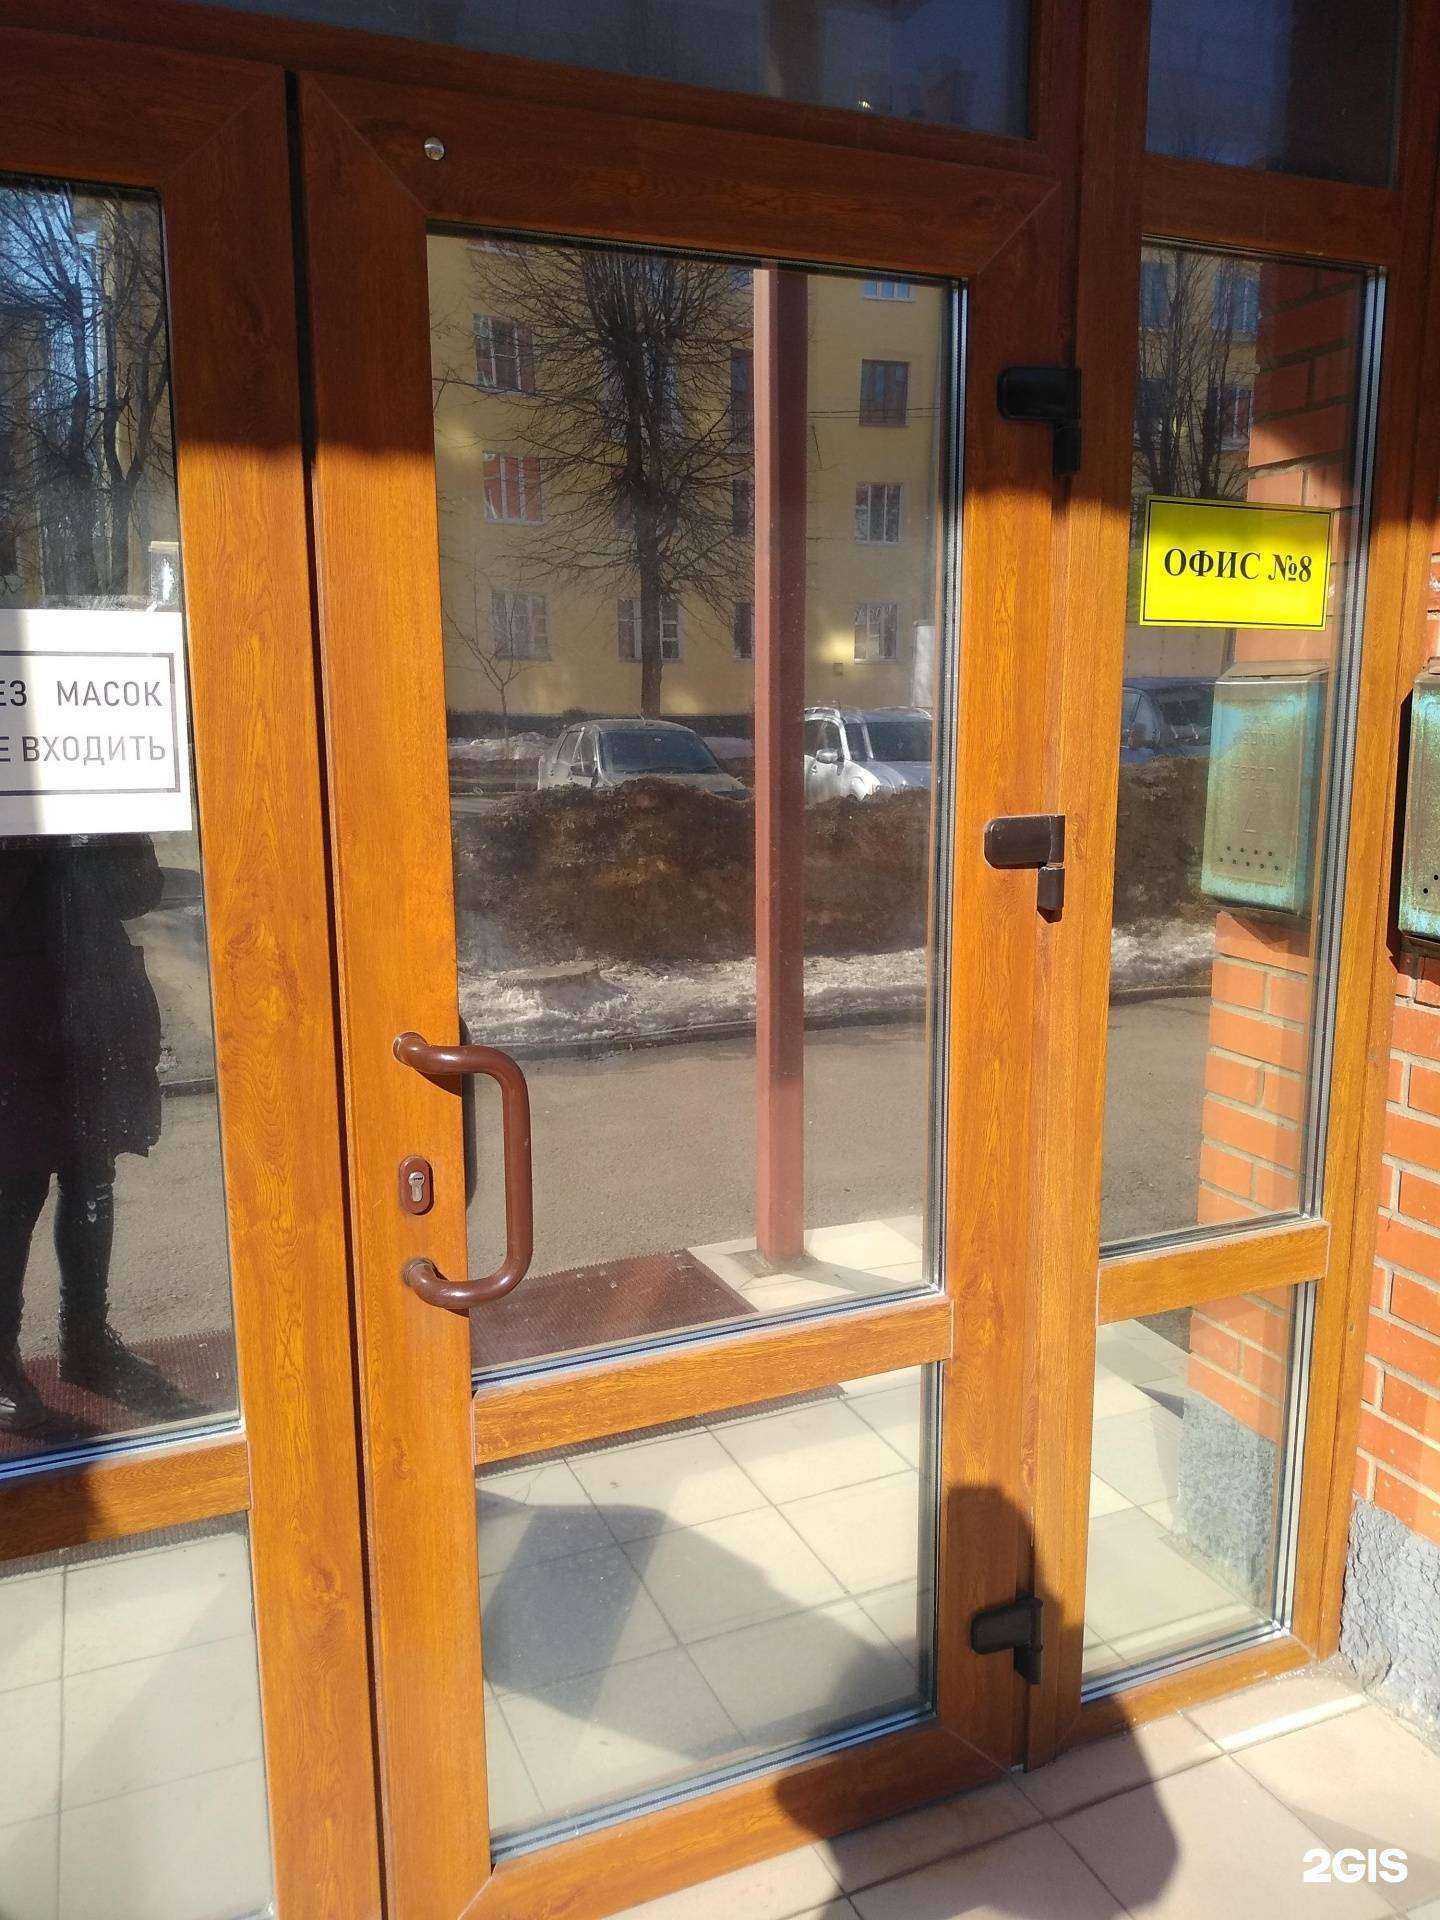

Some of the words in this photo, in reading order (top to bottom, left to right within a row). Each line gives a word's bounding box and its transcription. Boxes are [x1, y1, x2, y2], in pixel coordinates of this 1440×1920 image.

[1164, 548, 1261, 580] ОФИС
[1267, 554, 1312, 582] №8
[56, 680, 162, 707] МАСОК
[22, 736, 165, 766] ВХОДИТЬ
